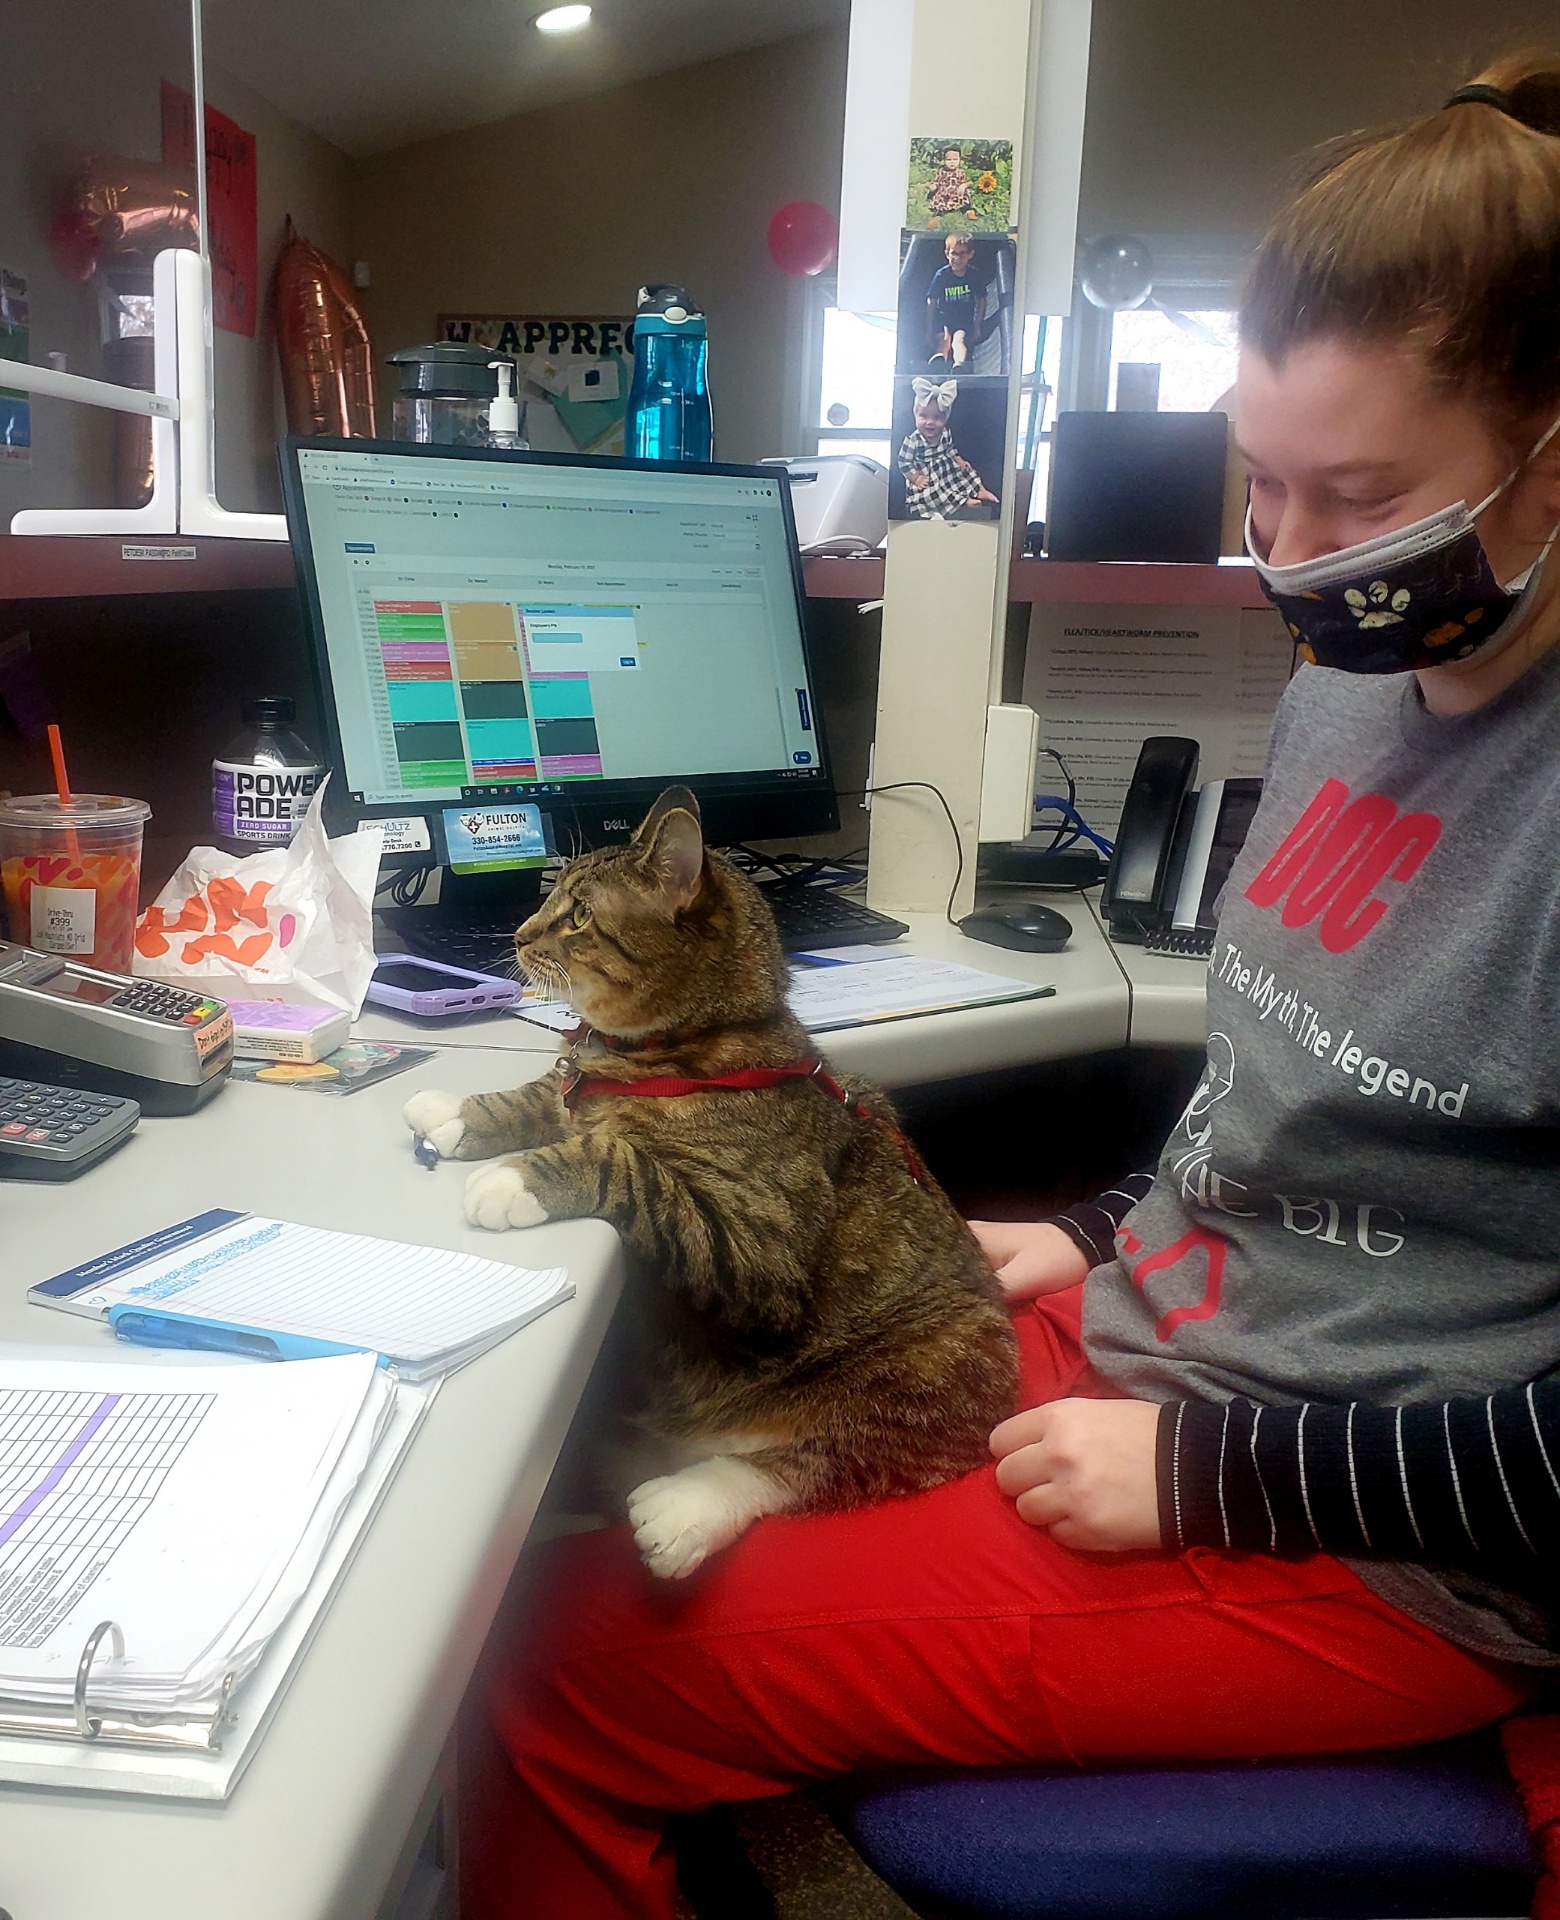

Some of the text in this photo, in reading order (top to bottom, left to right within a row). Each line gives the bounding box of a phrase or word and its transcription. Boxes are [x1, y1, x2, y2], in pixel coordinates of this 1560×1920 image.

[1063, 627, 1200, 639] FLEA/TICK/HEARTWORM PREVENTION
[237, 796, 292, 819] ADE
[486, 813, 527, 825] FULTON
[603, 818, 631, 831] DELL
[240, 822, 260, 830] ZERO
[237, 830, 266, 839] SPORTS
[471, 833, 521, 845] 330-854-2666
[50, 917, 71, 927] #399
[1218, 943, 1251, 993] The
[1247, 965, 1300, 1034] Myth,
[1295, 1001, 1331, 1058] The
[1331, 1029, 1470, 1118] legend
[76, 1259, 113, 1278] Member's
[112, 1251, 132, 1264] Mark
